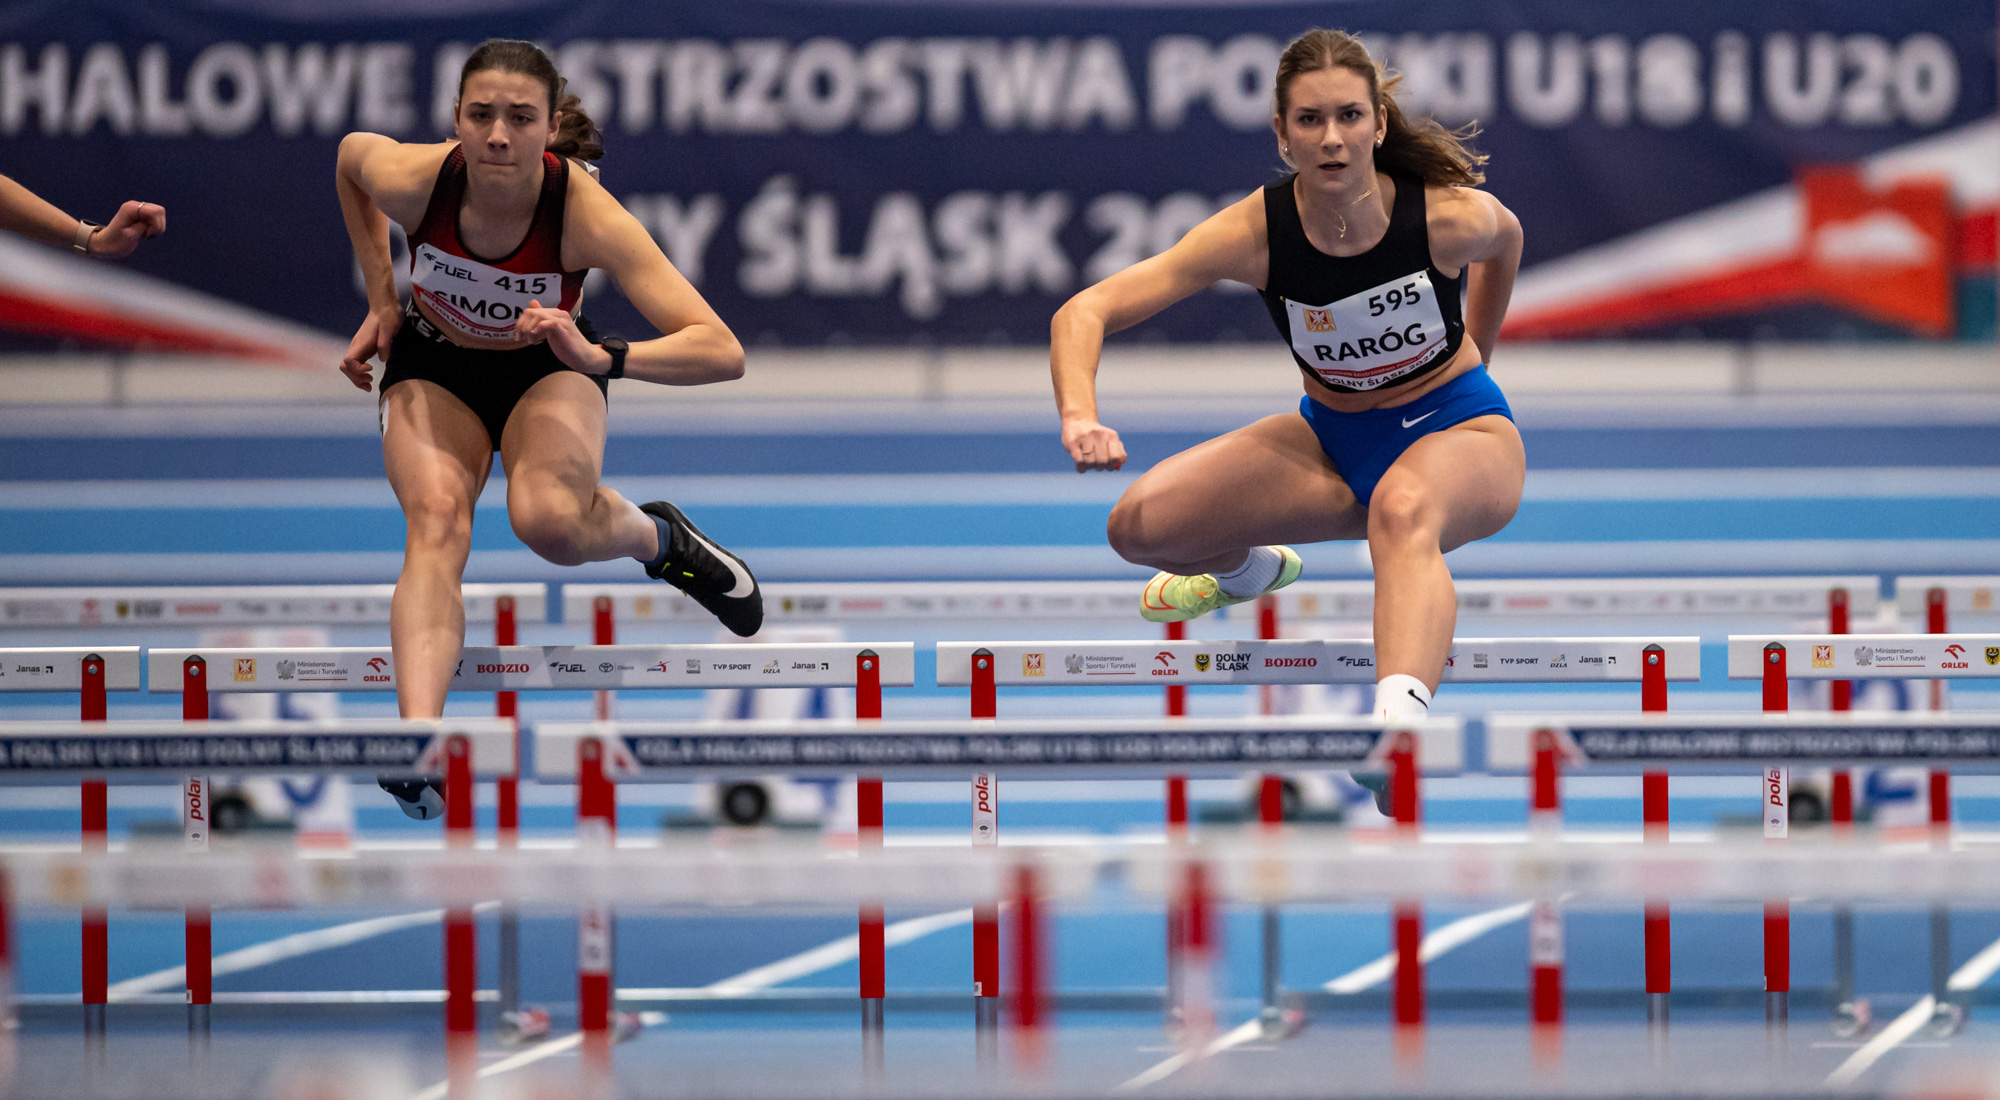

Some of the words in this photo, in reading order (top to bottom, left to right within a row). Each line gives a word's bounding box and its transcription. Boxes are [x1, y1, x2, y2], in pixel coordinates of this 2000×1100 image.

[3, 40, 413, 137] HALOWE
[434, 36, 1137, 135] STRZOSTWA
[1150, 35, 1492, 132] POKI
[1506, 33, 1698, 128] U18
[1763, 32, 1958, 127] U20
[738, 172, 1073, 317] ŚLĄSK
[433, 261, 478, 282] FUEL
[494, 276, 547, 295] 415
[1368, 282, 1421, 317] 595
[1313, 323, 1427, 362] RARÓG
[1408, 349, 1435, 371] 2024
[1216, 653, 1251, 662] DOLNY
[1264, 658, 1317, 668] BODZIO
[1346, 658, 1374, 666] FUEL
[1578, 656, 1603, 664] Janas
[476, 663, 530, 674] BODZIO
[559, 664, 586, 672] FUEL
[791, 661, 816, 669] Janas
[1085, 662, 1105, 670] Sportu
[1110, 662, 1136, 670] Turystyki
[1216, 661, 1249, 672] ŚLĄSK
[297, 668, 317, 676] Sportu
[322, 668, 348, 676] Turystyki
